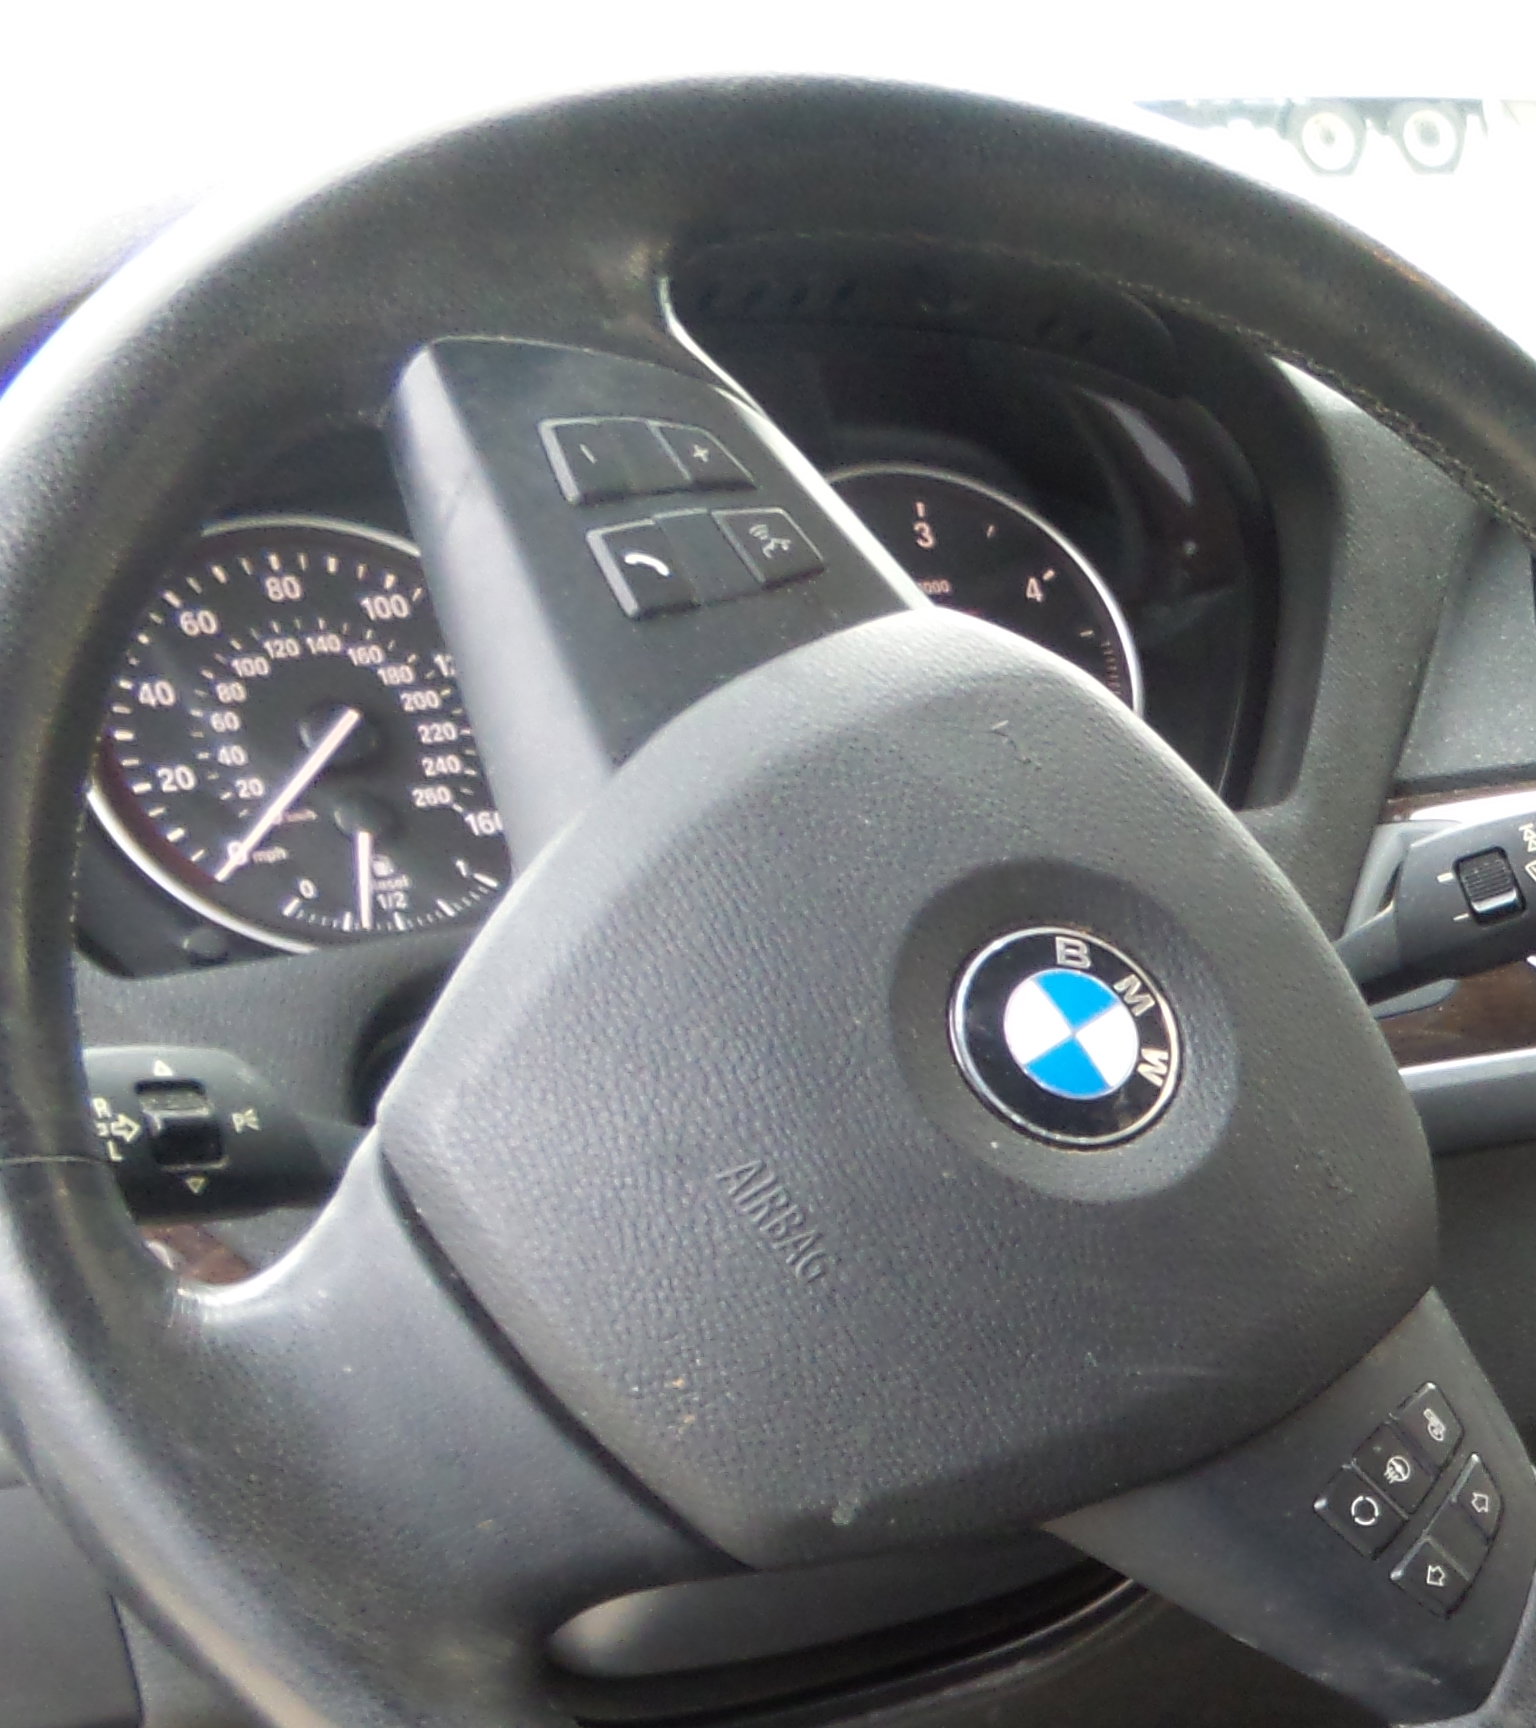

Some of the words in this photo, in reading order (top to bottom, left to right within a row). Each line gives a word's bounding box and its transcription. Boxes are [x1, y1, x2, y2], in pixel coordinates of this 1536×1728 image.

[914, 521, 936, 550] 3
[265, 575, 302, 603] 80
[1025, 576, 1044, 603] 4
[360, 593, 411, 622] 100
[179, 609, 219, 637] 60
[263, 637, 300, 659] 120
[306, 634, 342, 655] 140
[231, 656, 270, 678] 100
[138, 679, 176, 708] 40
[401, 690, 441, 713] 200
[210, 710, 241, 733] 60
[417, 721, 458, 745] 220
[217, 744, 248, 767] 40
[421, 754, 462, 777] 240
[157, 764, 198, 794] 20
[234, 777, 265, 799] 20
[299, 877, 317, 900] 0
[376, 891, 409, 912] 1/2
[1055, 936, 1169, 1087] BMW
[715, 1159, 826, 1283] AIRBAG
